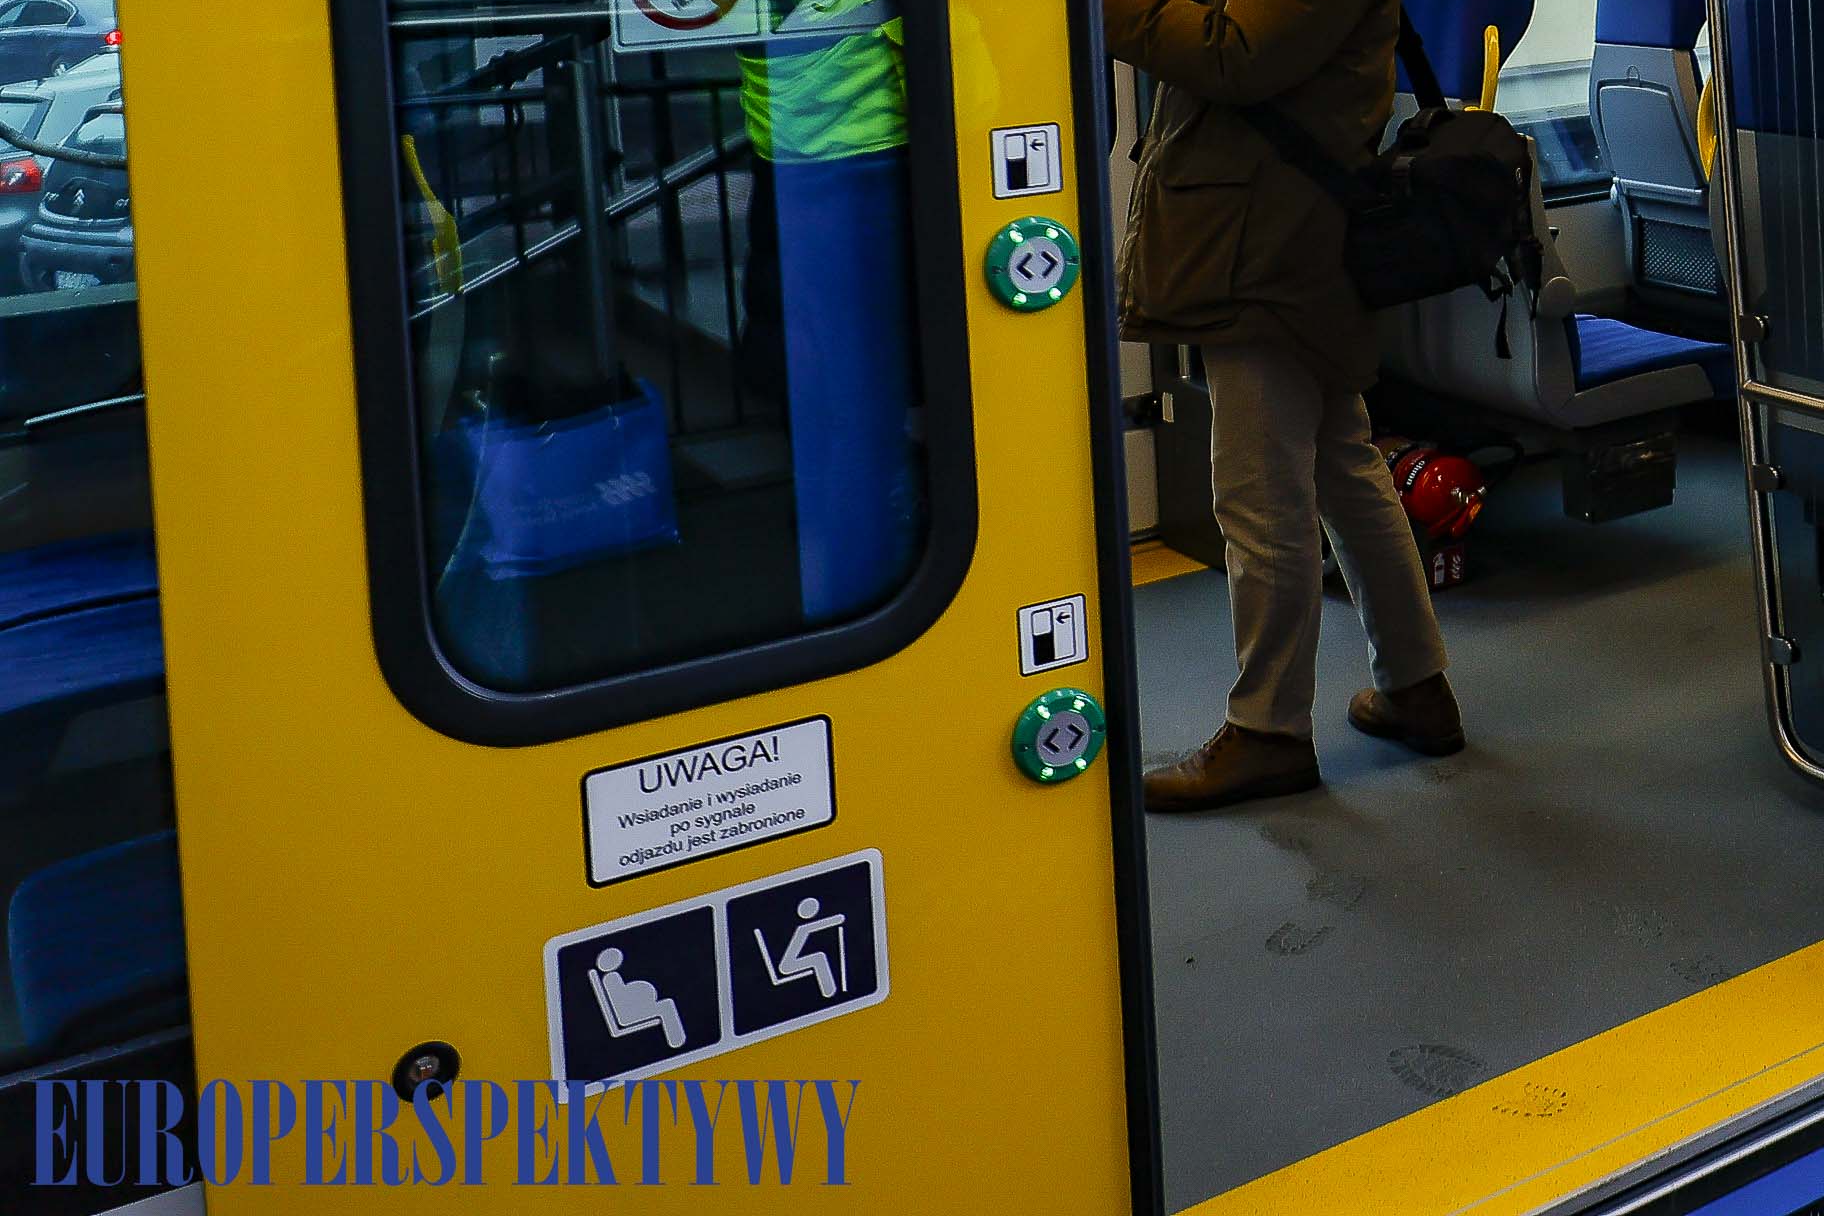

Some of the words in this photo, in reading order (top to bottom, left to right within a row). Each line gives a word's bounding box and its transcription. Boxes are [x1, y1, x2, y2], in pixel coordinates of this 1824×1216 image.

[639, 736, 780, 794] UWAGA!
[617, 797, 704, 829] Wsiadanie
[716, 772, 802, 804] wysiadanie
[670, 819, 691, 837] po
[694, 801, 756, 830] sygnale
[618, 836, 683, 867] odjazdu
[686, 829, 716, 852] jest
[719, 807, 806, 840] zabronione
